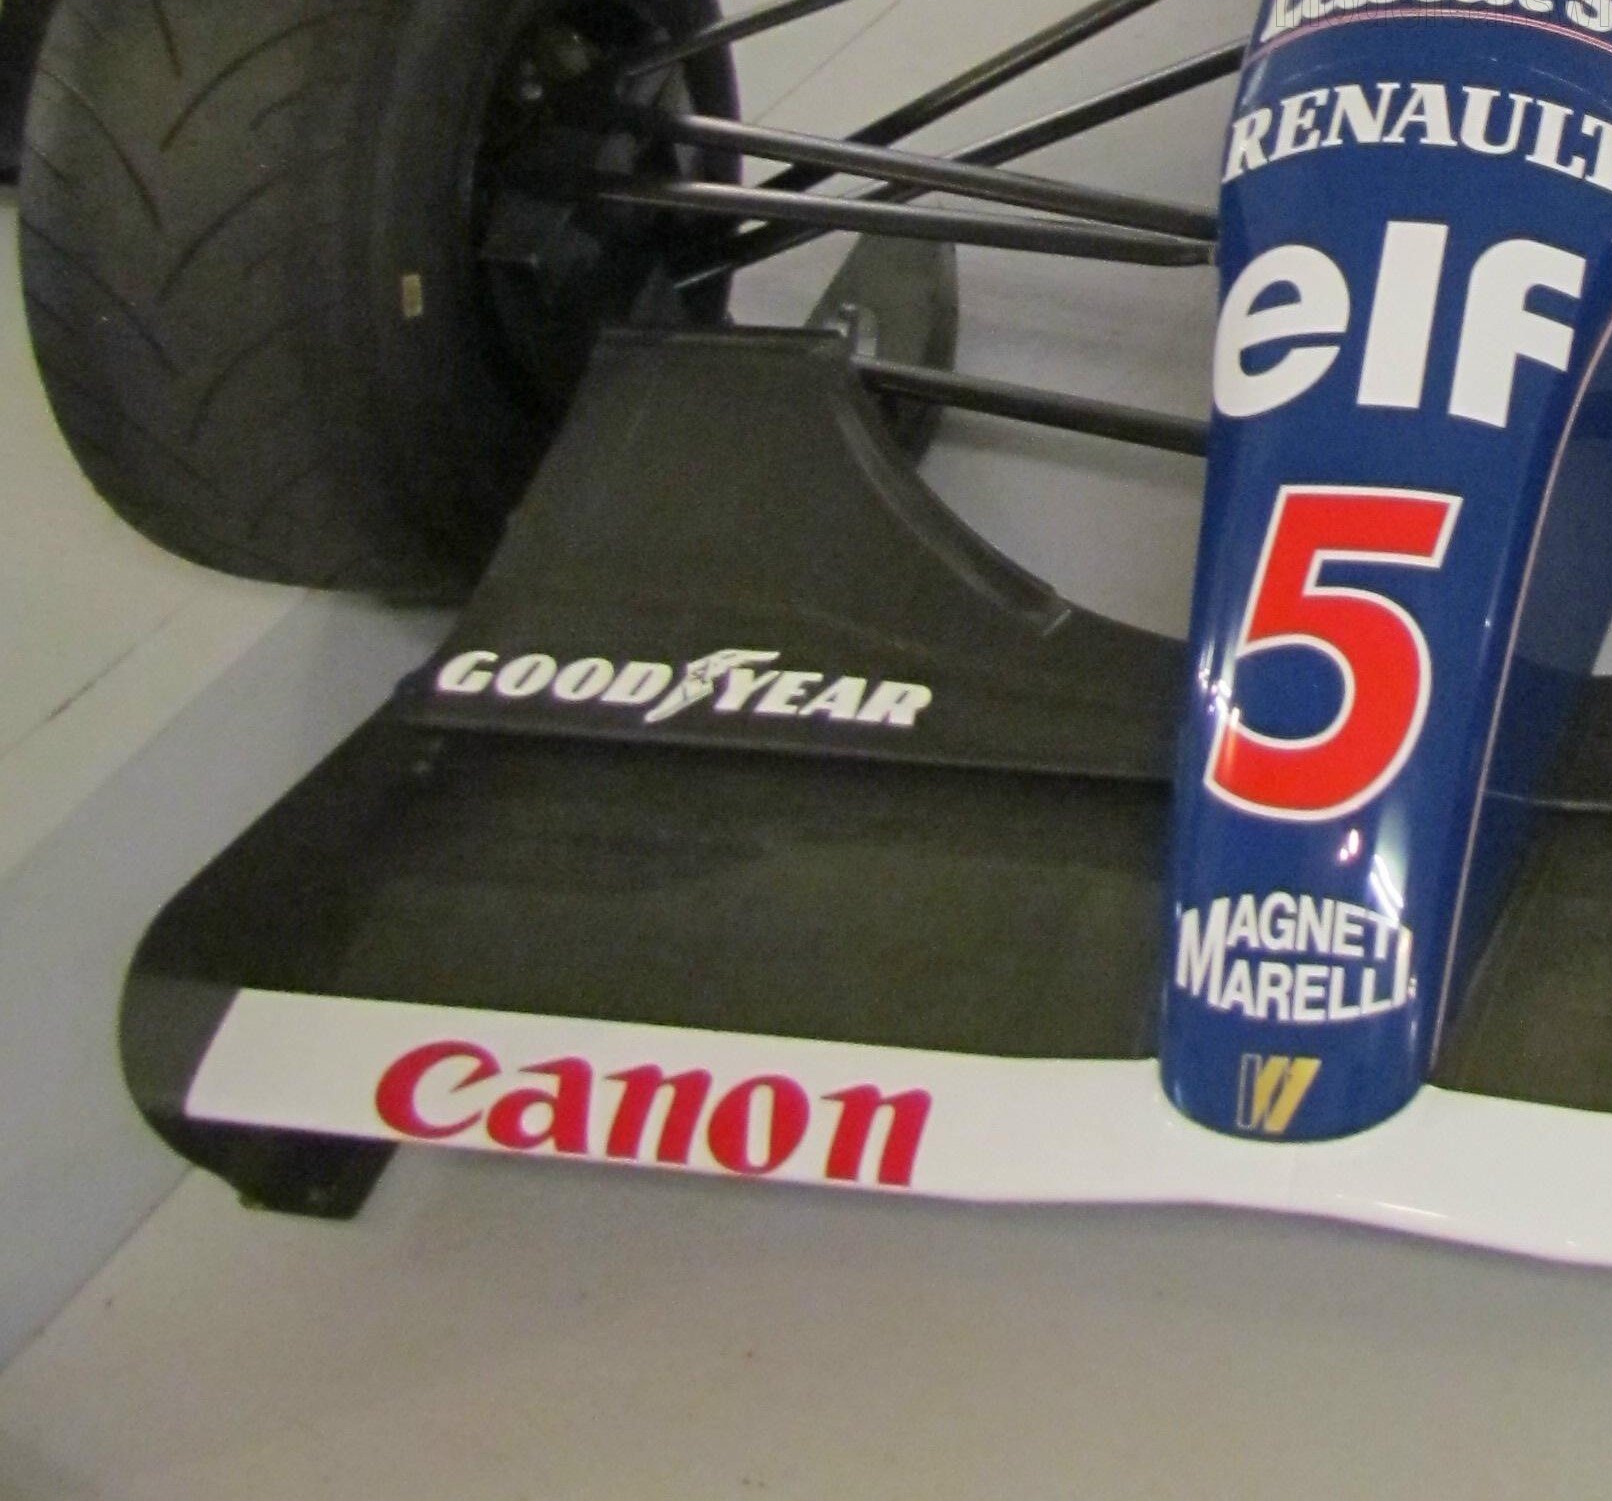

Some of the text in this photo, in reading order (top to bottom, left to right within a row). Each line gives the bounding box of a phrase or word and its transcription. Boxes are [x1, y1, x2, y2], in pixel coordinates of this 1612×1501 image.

[1213, 220, 1587, 430] elf
[1203, 484, 1464, 822] 5
[375, 1039, 933, 1188] Canon
